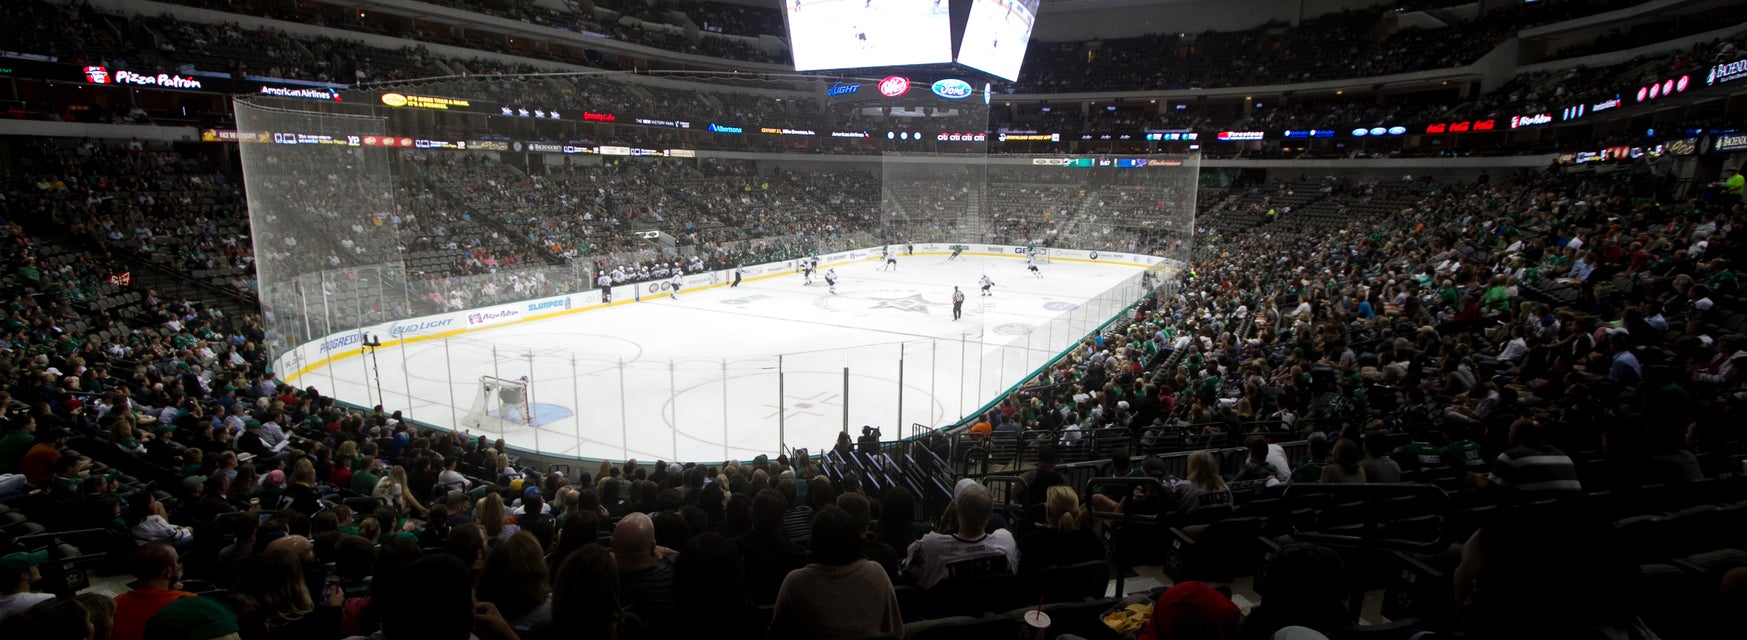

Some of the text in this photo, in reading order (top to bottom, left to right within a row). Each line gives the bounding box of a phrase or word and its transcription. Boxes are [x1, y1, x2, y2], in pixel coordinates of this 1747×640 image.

[116, 71, 155, 86] Pizza
[261, 86, 331, 100] American Airlines
[835, 84, 860, 94] LIGHT
[940, 85, 966, 96] Ford
[528, 299, 564, 311] SLURPEE
[483, 312, 500, 322] Pizza
[393, 318, 454, 335] BUD LIGHT
